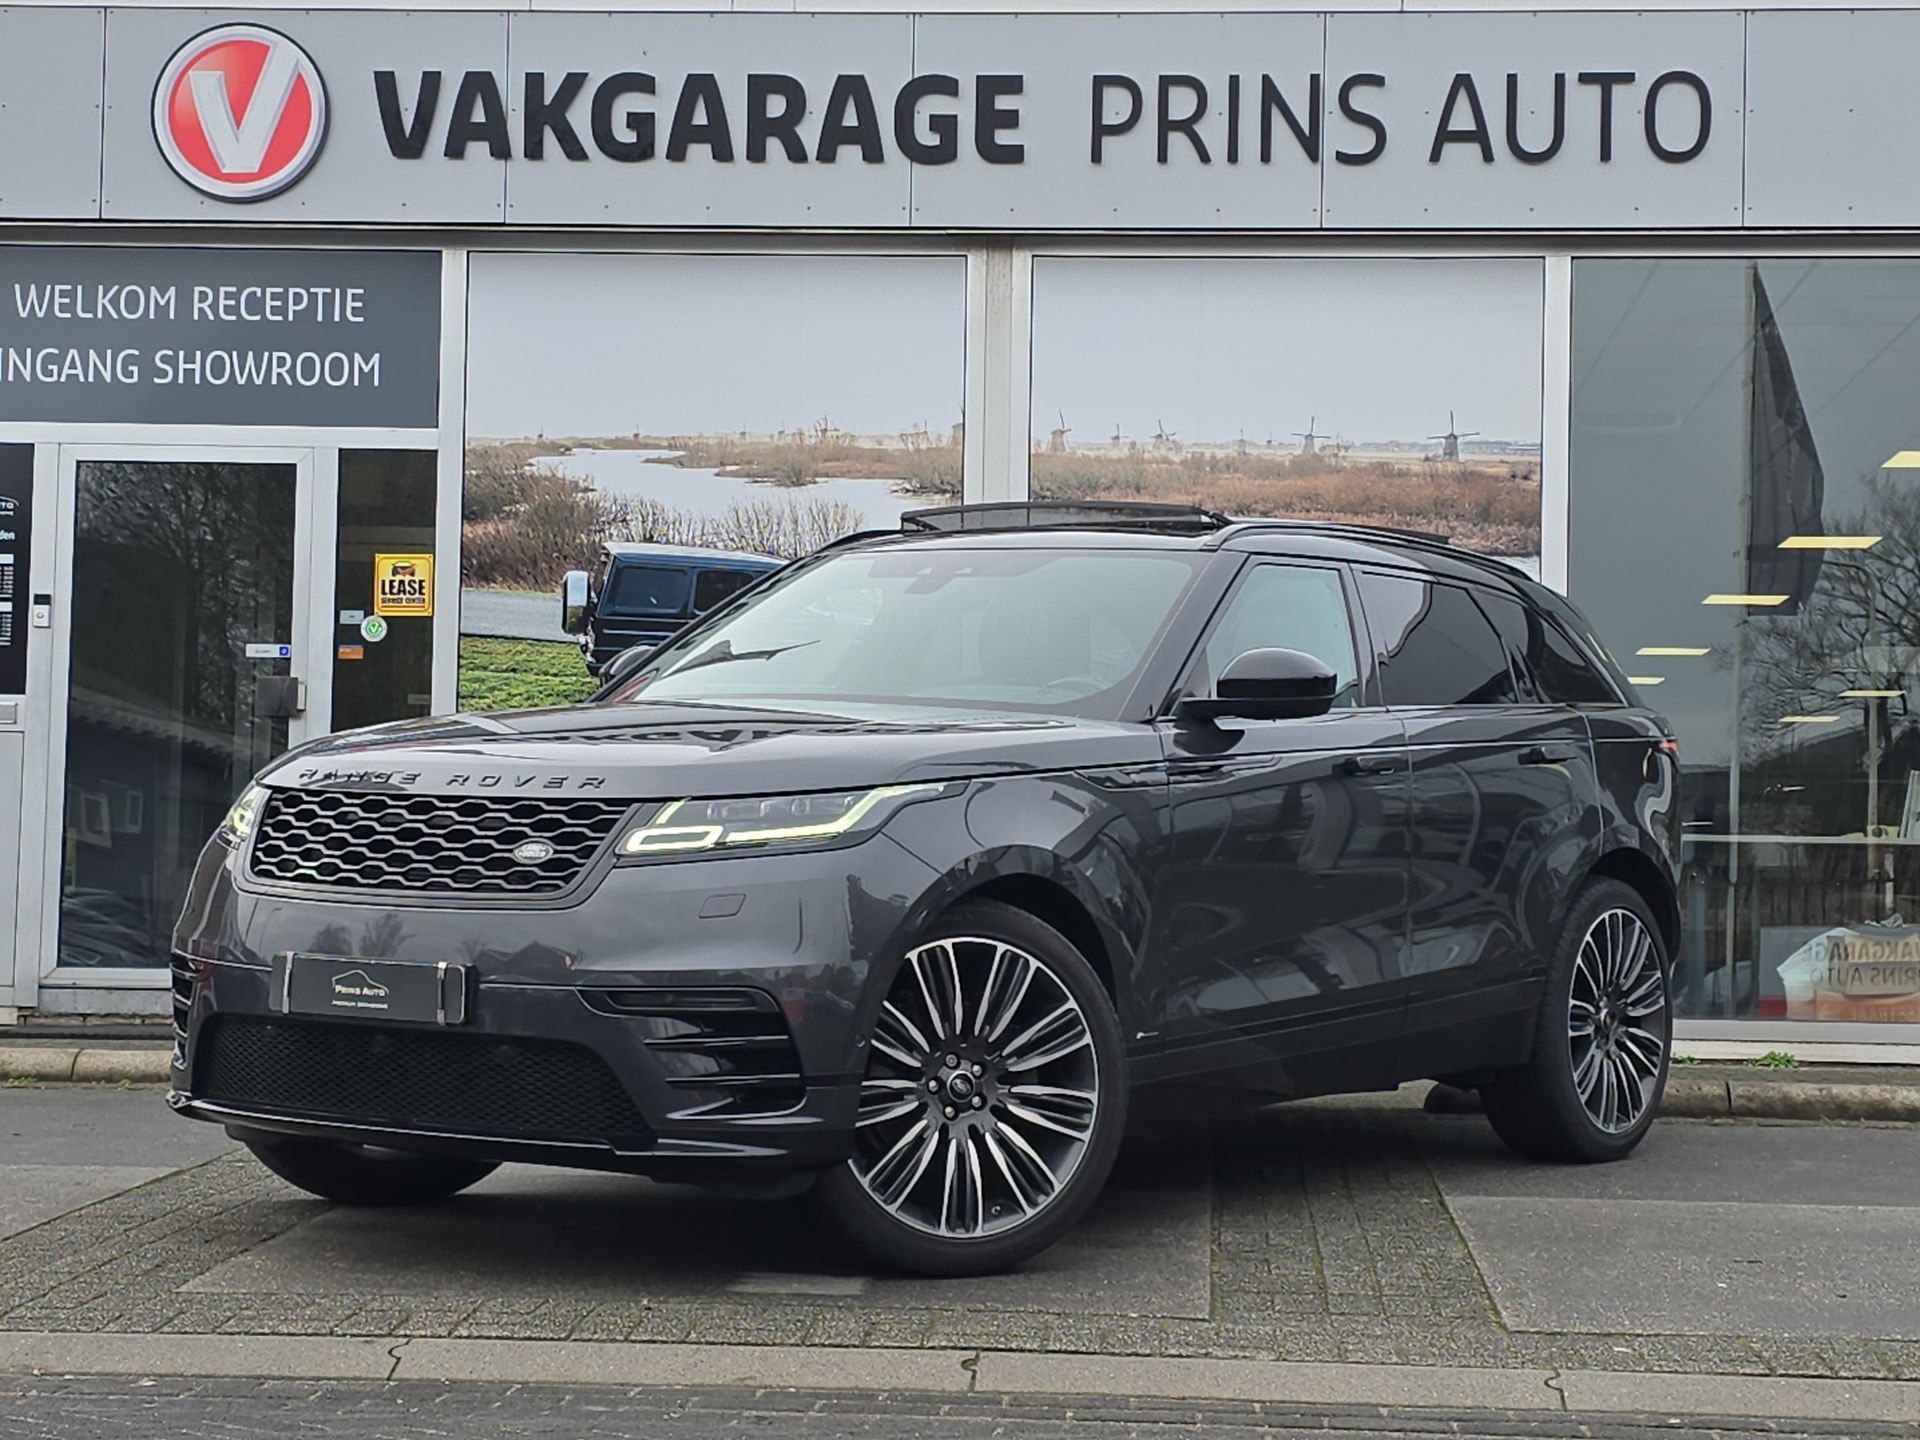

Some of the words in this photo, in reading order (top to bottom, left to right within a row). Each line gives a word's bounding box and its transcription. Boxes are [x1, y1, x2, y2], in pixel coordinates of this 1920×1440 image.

[373, 70, 1025, 165] VAKGARAGE
[1090, 73, 1387, 166] PRINS
[1428, 70, 1713, 165] AUTO
[14, 283, 176, 320] WELKOM
[193, 286, 364, 322] RECEPTIE
[153, 349, 380, 387] SHOWROOM
[381, 579, 426, 596] LEASE
[299, 768, 422, 786] RANGE
[446, 774, 606, 790] ROVER
